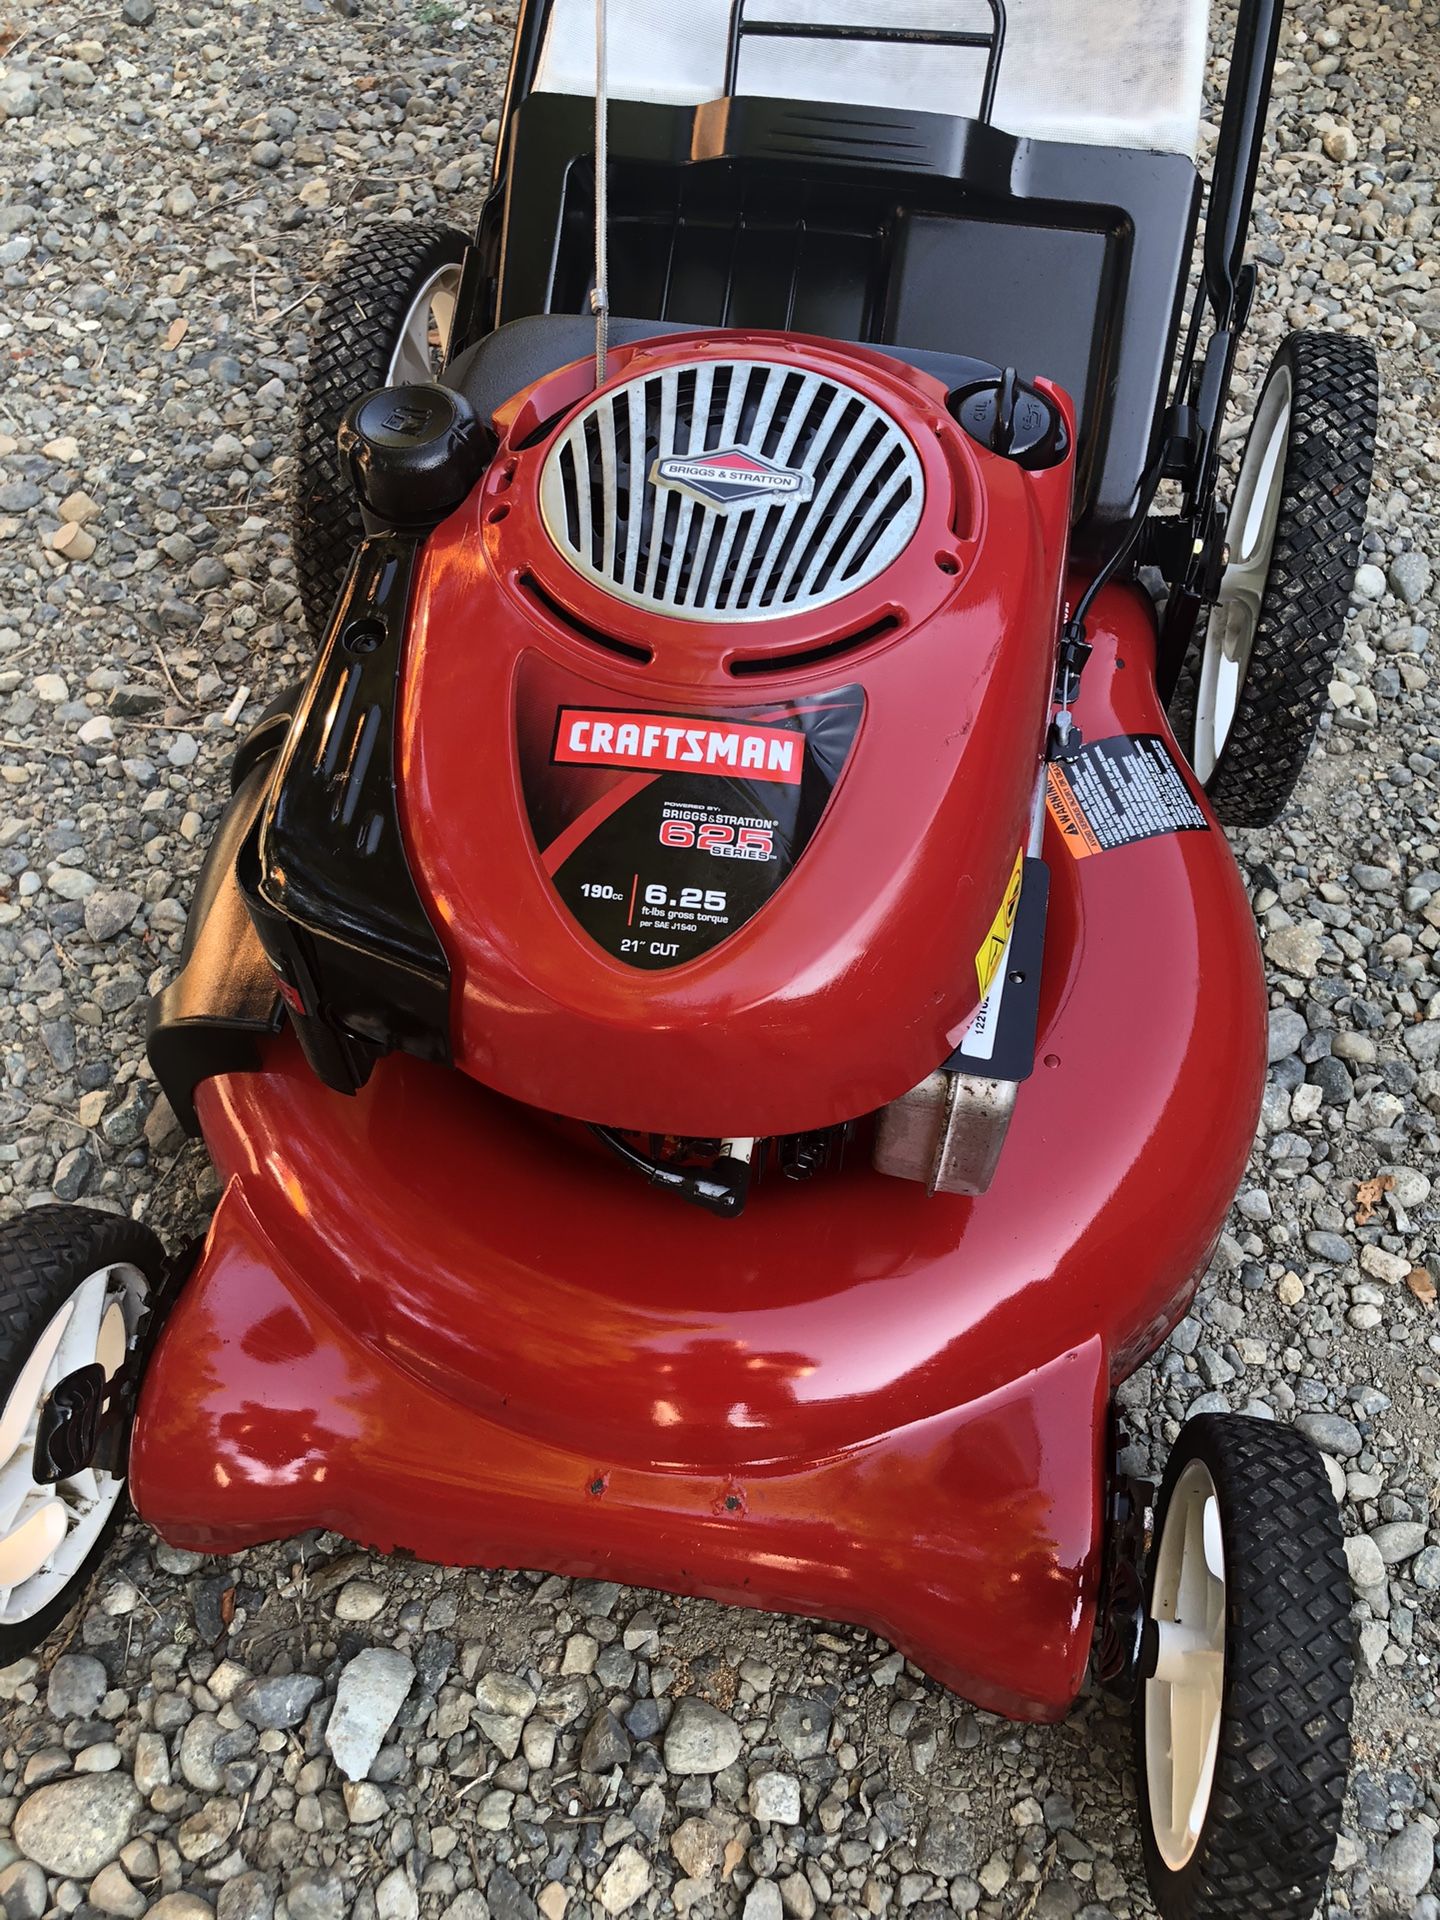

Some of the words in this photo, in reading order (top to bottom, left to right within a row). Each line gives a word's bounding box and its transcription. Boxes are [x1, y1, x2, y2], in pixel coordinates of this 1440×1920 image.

[974, 399, 989, 423] OIL
[669, 465, 715, 478] BRIGGS
[718, 470, 727, 479] &
[729, 472, 792, 486] STRATTON
[568, 720, 794, 772] CRAFTSMAN
[664, 801, 705, 810] POWERED
[1072, 806, 1088, 829] SERIOUS
[660, 819, 773, 854] 625
[644, 883, 727, 911] 6.25
[639, 920, 653, 928] per
[654, 920, 670, 929] SAE
[641, 906, 666, 917] ft-lbs
[667, 911, 695, 920] gross
[696, 911, 730, 924] torque
[650, 942, 680, 957] CUT
